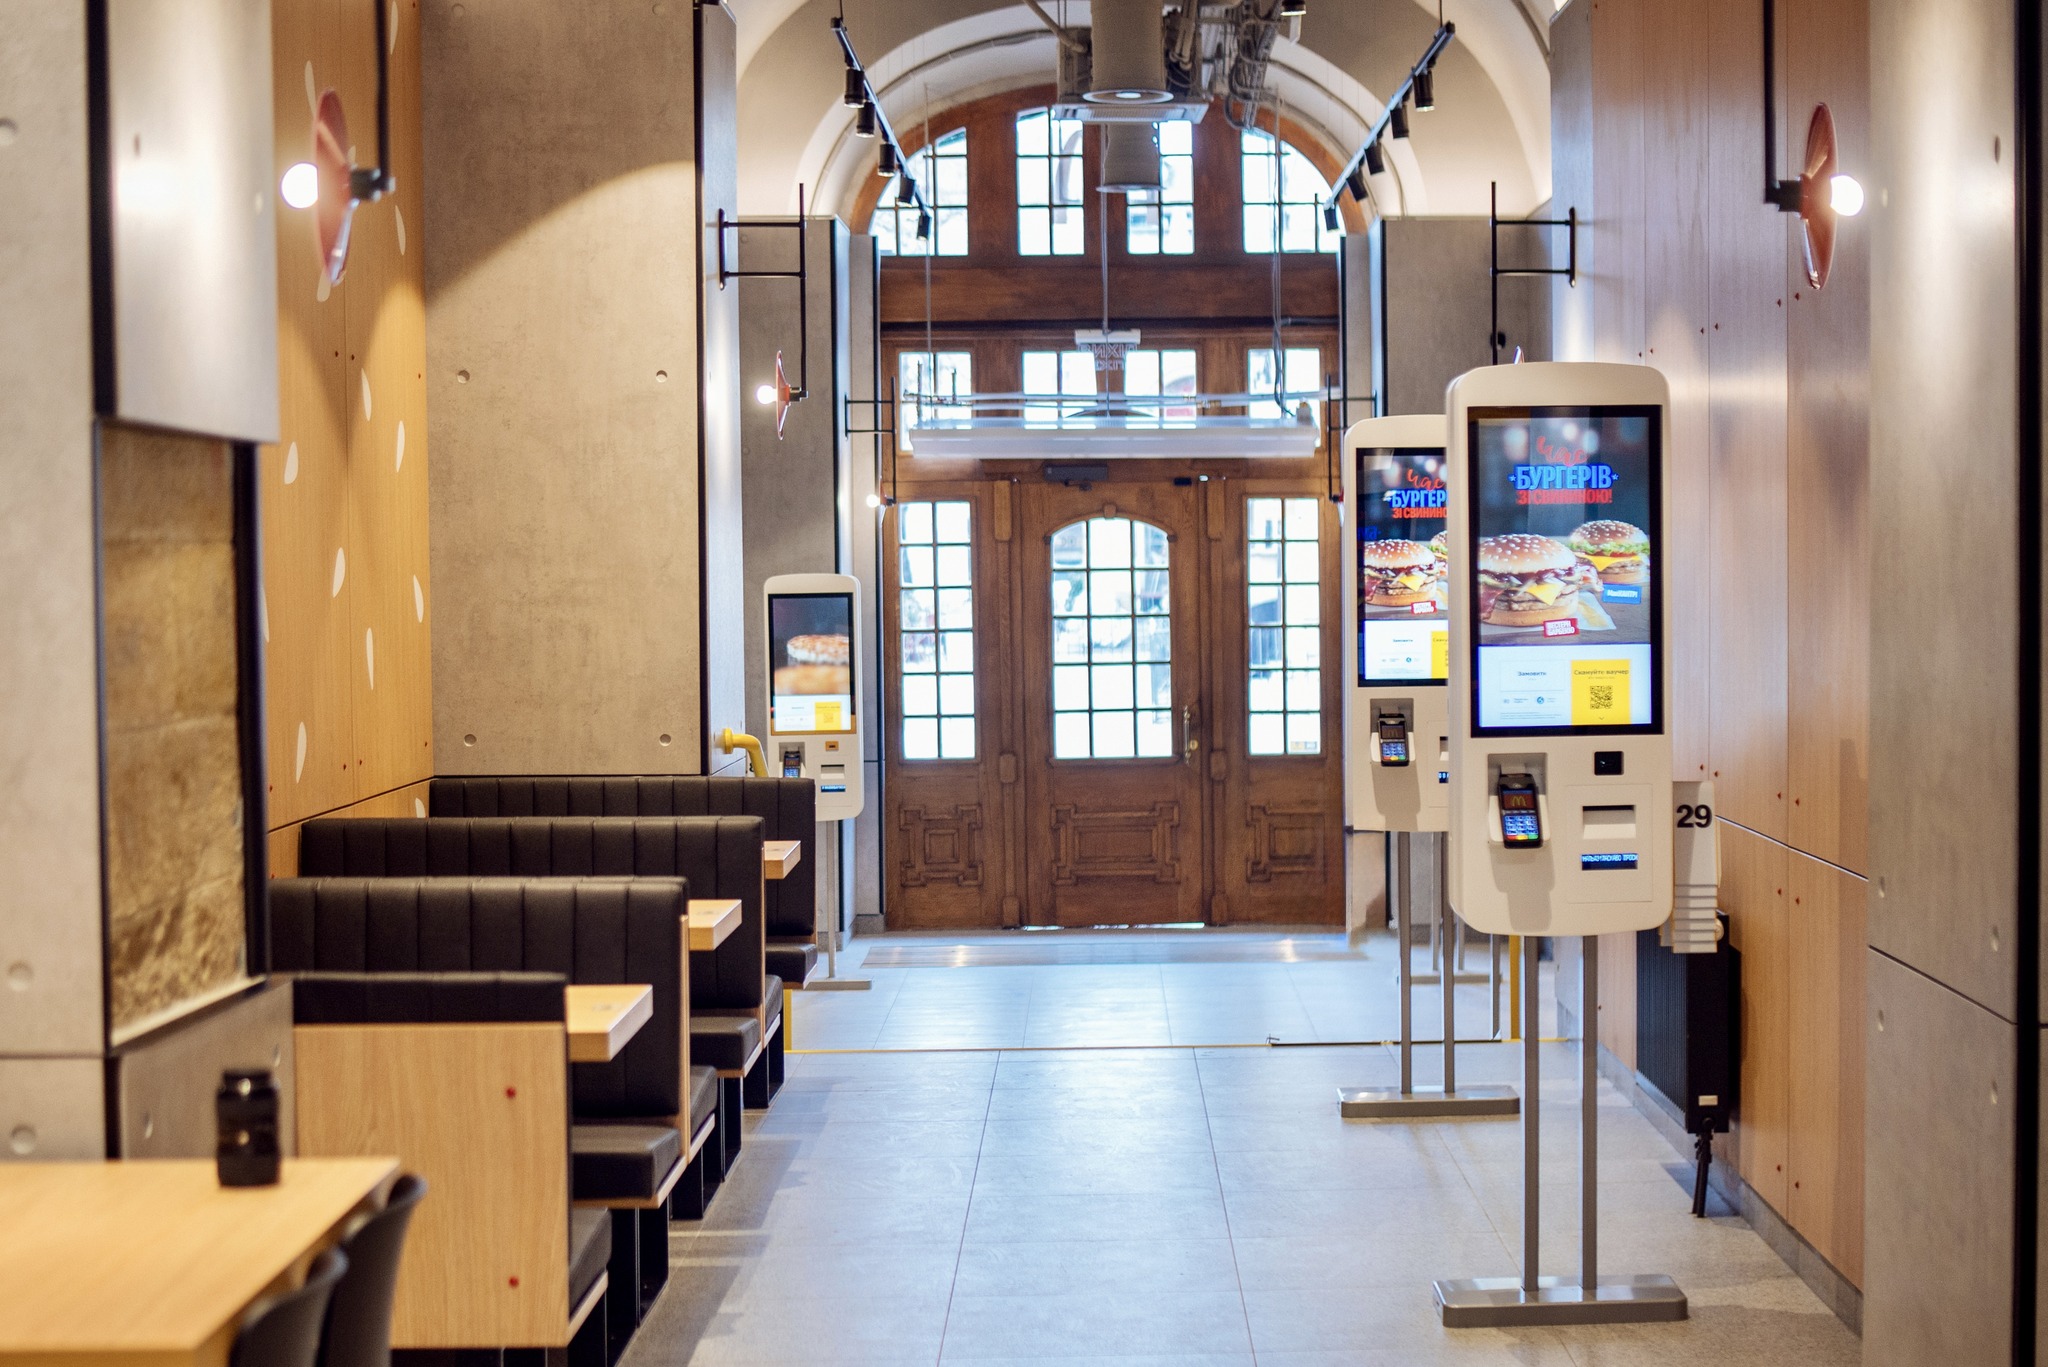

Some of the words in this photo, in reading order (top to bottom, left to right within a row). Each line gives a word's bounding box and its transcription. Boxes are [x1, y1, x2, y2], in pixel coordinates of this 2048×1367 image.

[1515, 465, 1613, 490] БУРГЕРІВ
[1391, 489, 1449, 508] БУРГЕР
[1404, 507, 1449, 518] СВИНИНО
[1676, 804, 1712, 828] 29
